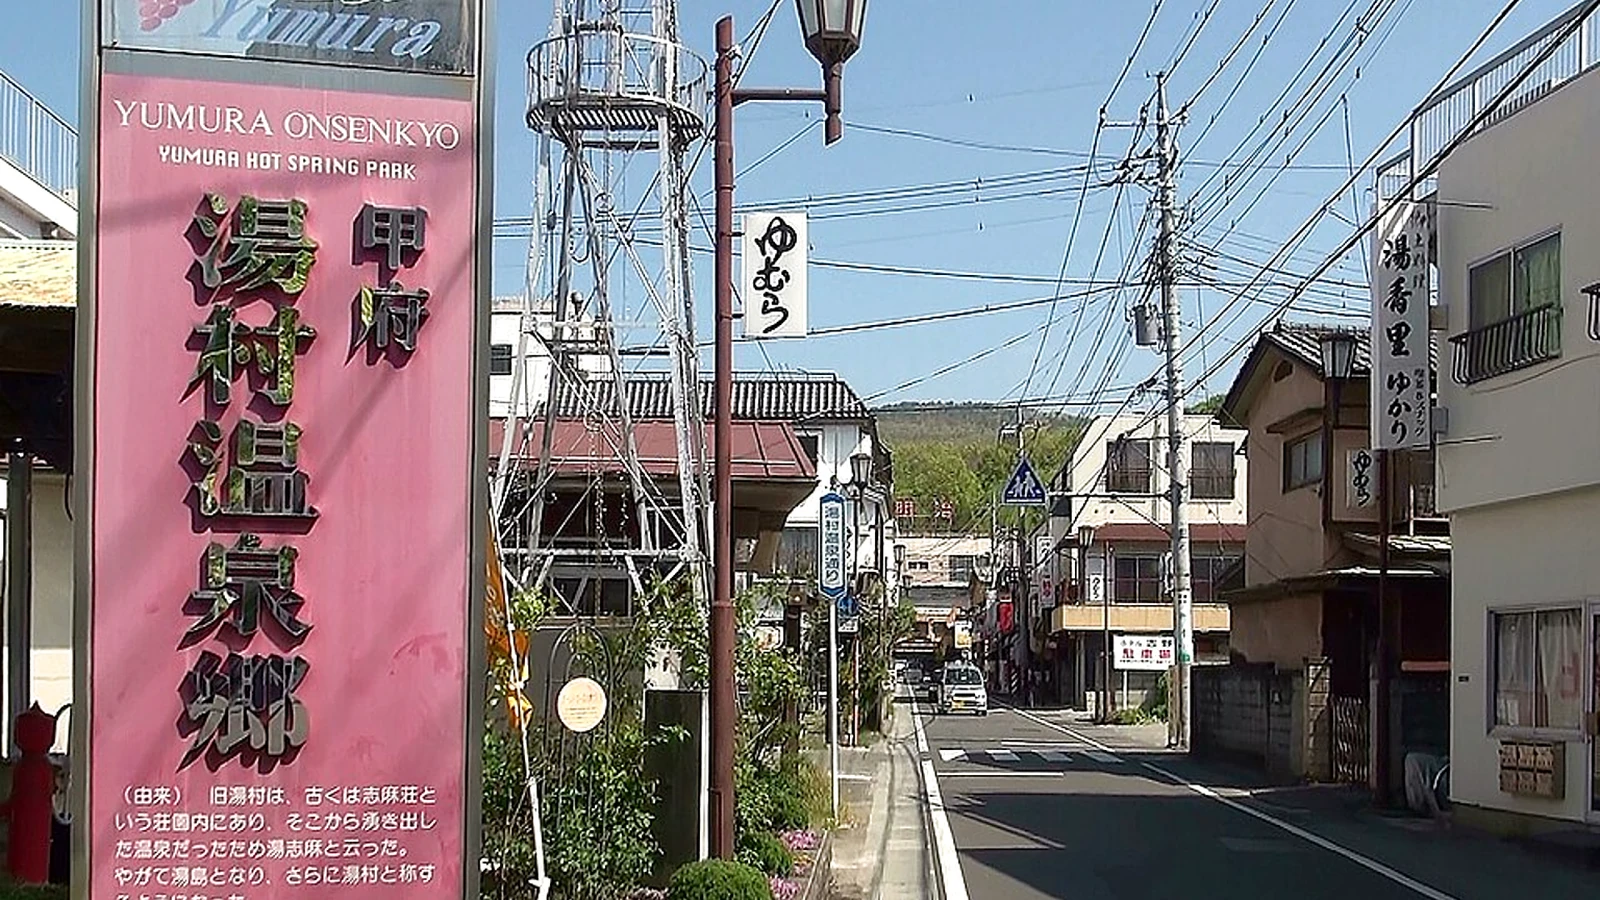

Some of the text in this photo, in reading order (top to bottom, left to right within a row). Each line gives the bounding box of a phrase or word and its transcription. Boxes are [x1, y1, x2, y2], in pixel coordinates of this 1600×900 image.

[114, 100, 461, 150] YUMURA ONSENKYO
[159, 146, 418, 182] YUMURA HOT SPRING PARK
[348, 201, 430, 366] 甲府
[754, 216, 797, 334] ゆむら
[1386, 371, 1412, 444] ゆかり
[182, 193, 318, 772] 湯村温泉郷
